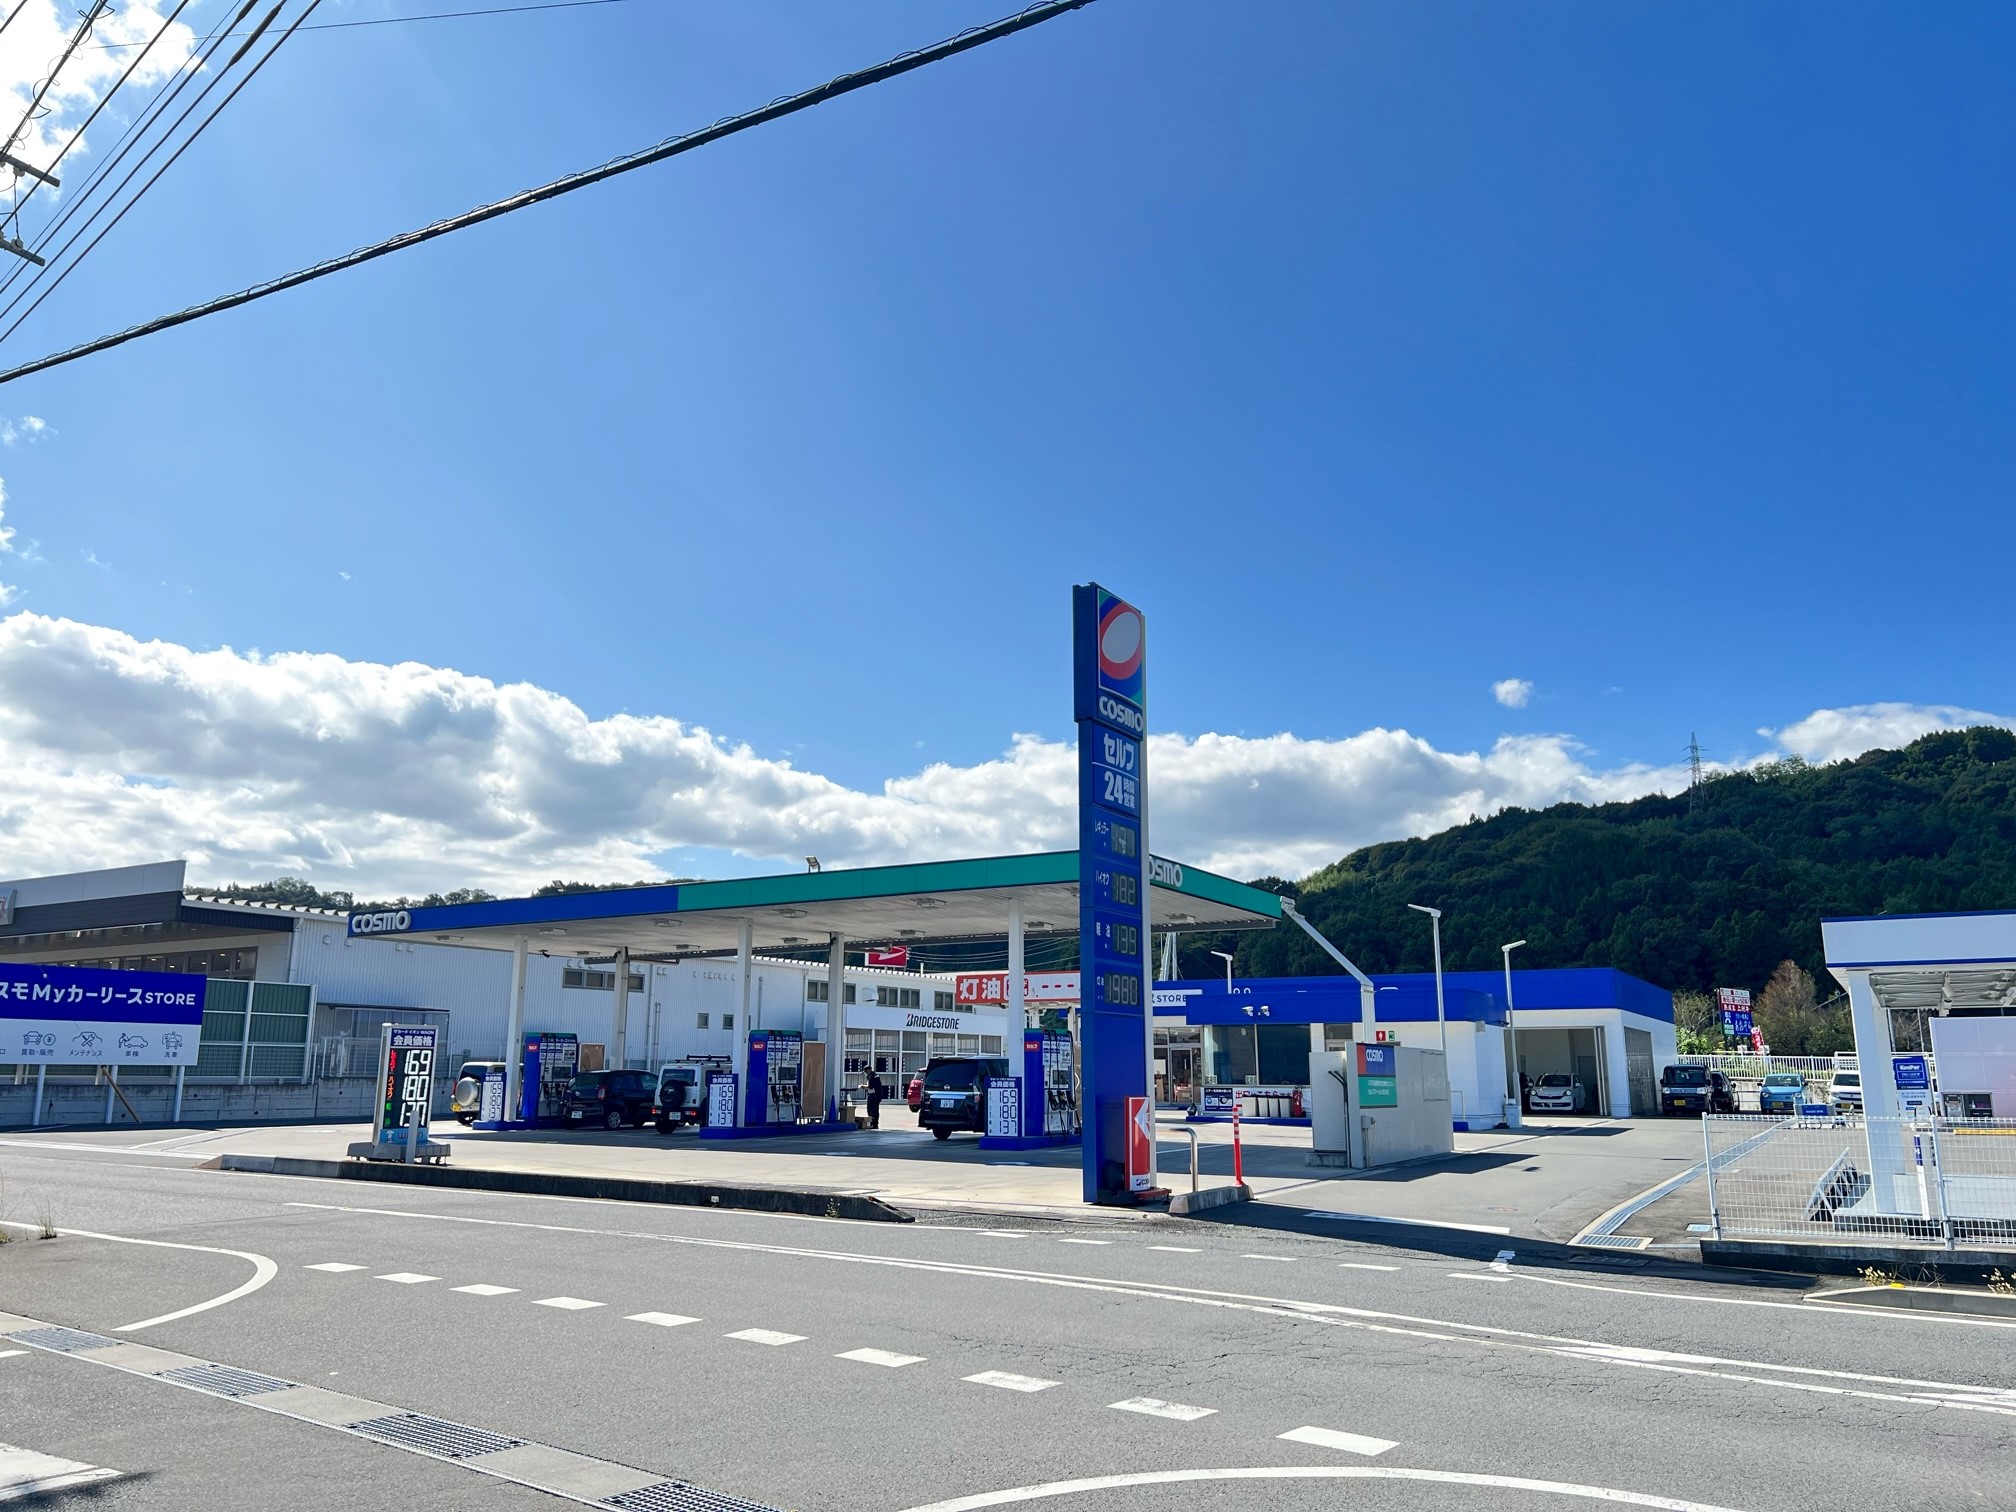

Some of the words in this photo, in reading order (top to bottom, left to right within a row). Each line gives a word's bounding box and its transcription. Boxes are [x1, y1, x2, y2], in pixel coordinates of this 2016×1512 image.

[1099, 696, 1143, 732] COSMO
[1104, 733, 1134, 770] セルフ
[1104, 771, 1123, 804] 24
[1096, 870, 1110, 885] ハイオク
[1115, 874, 1136, 905] 182
[352, 911, 411, 932] COSMO
[1116, 925, 1137, 955] 139
[960, 977, 1001, 1000] 灯油
[1107, 974, 1138, 1005] 1980
[906, 1013, 960, 1029] BRIDGESTONE
[393, 1035, 433, 1046] 会員価格
[68, 1049, 103, 1057] メンテナンス
[1366, 1049, 1384, 1062] COSMO
[404, 1050, 432, 1074] 169
[402, 1076, 429, 1100] 180
[719, 1085, 733, 1098] 169
[718, 1099, 732, 1111] 180
[999, 1090, 1017, 1104] 169
[717, 1112, 732, 1125] 137
[999, 1105, 1017, 1119] 180
[999, 1119, 1017, 1135] 137
